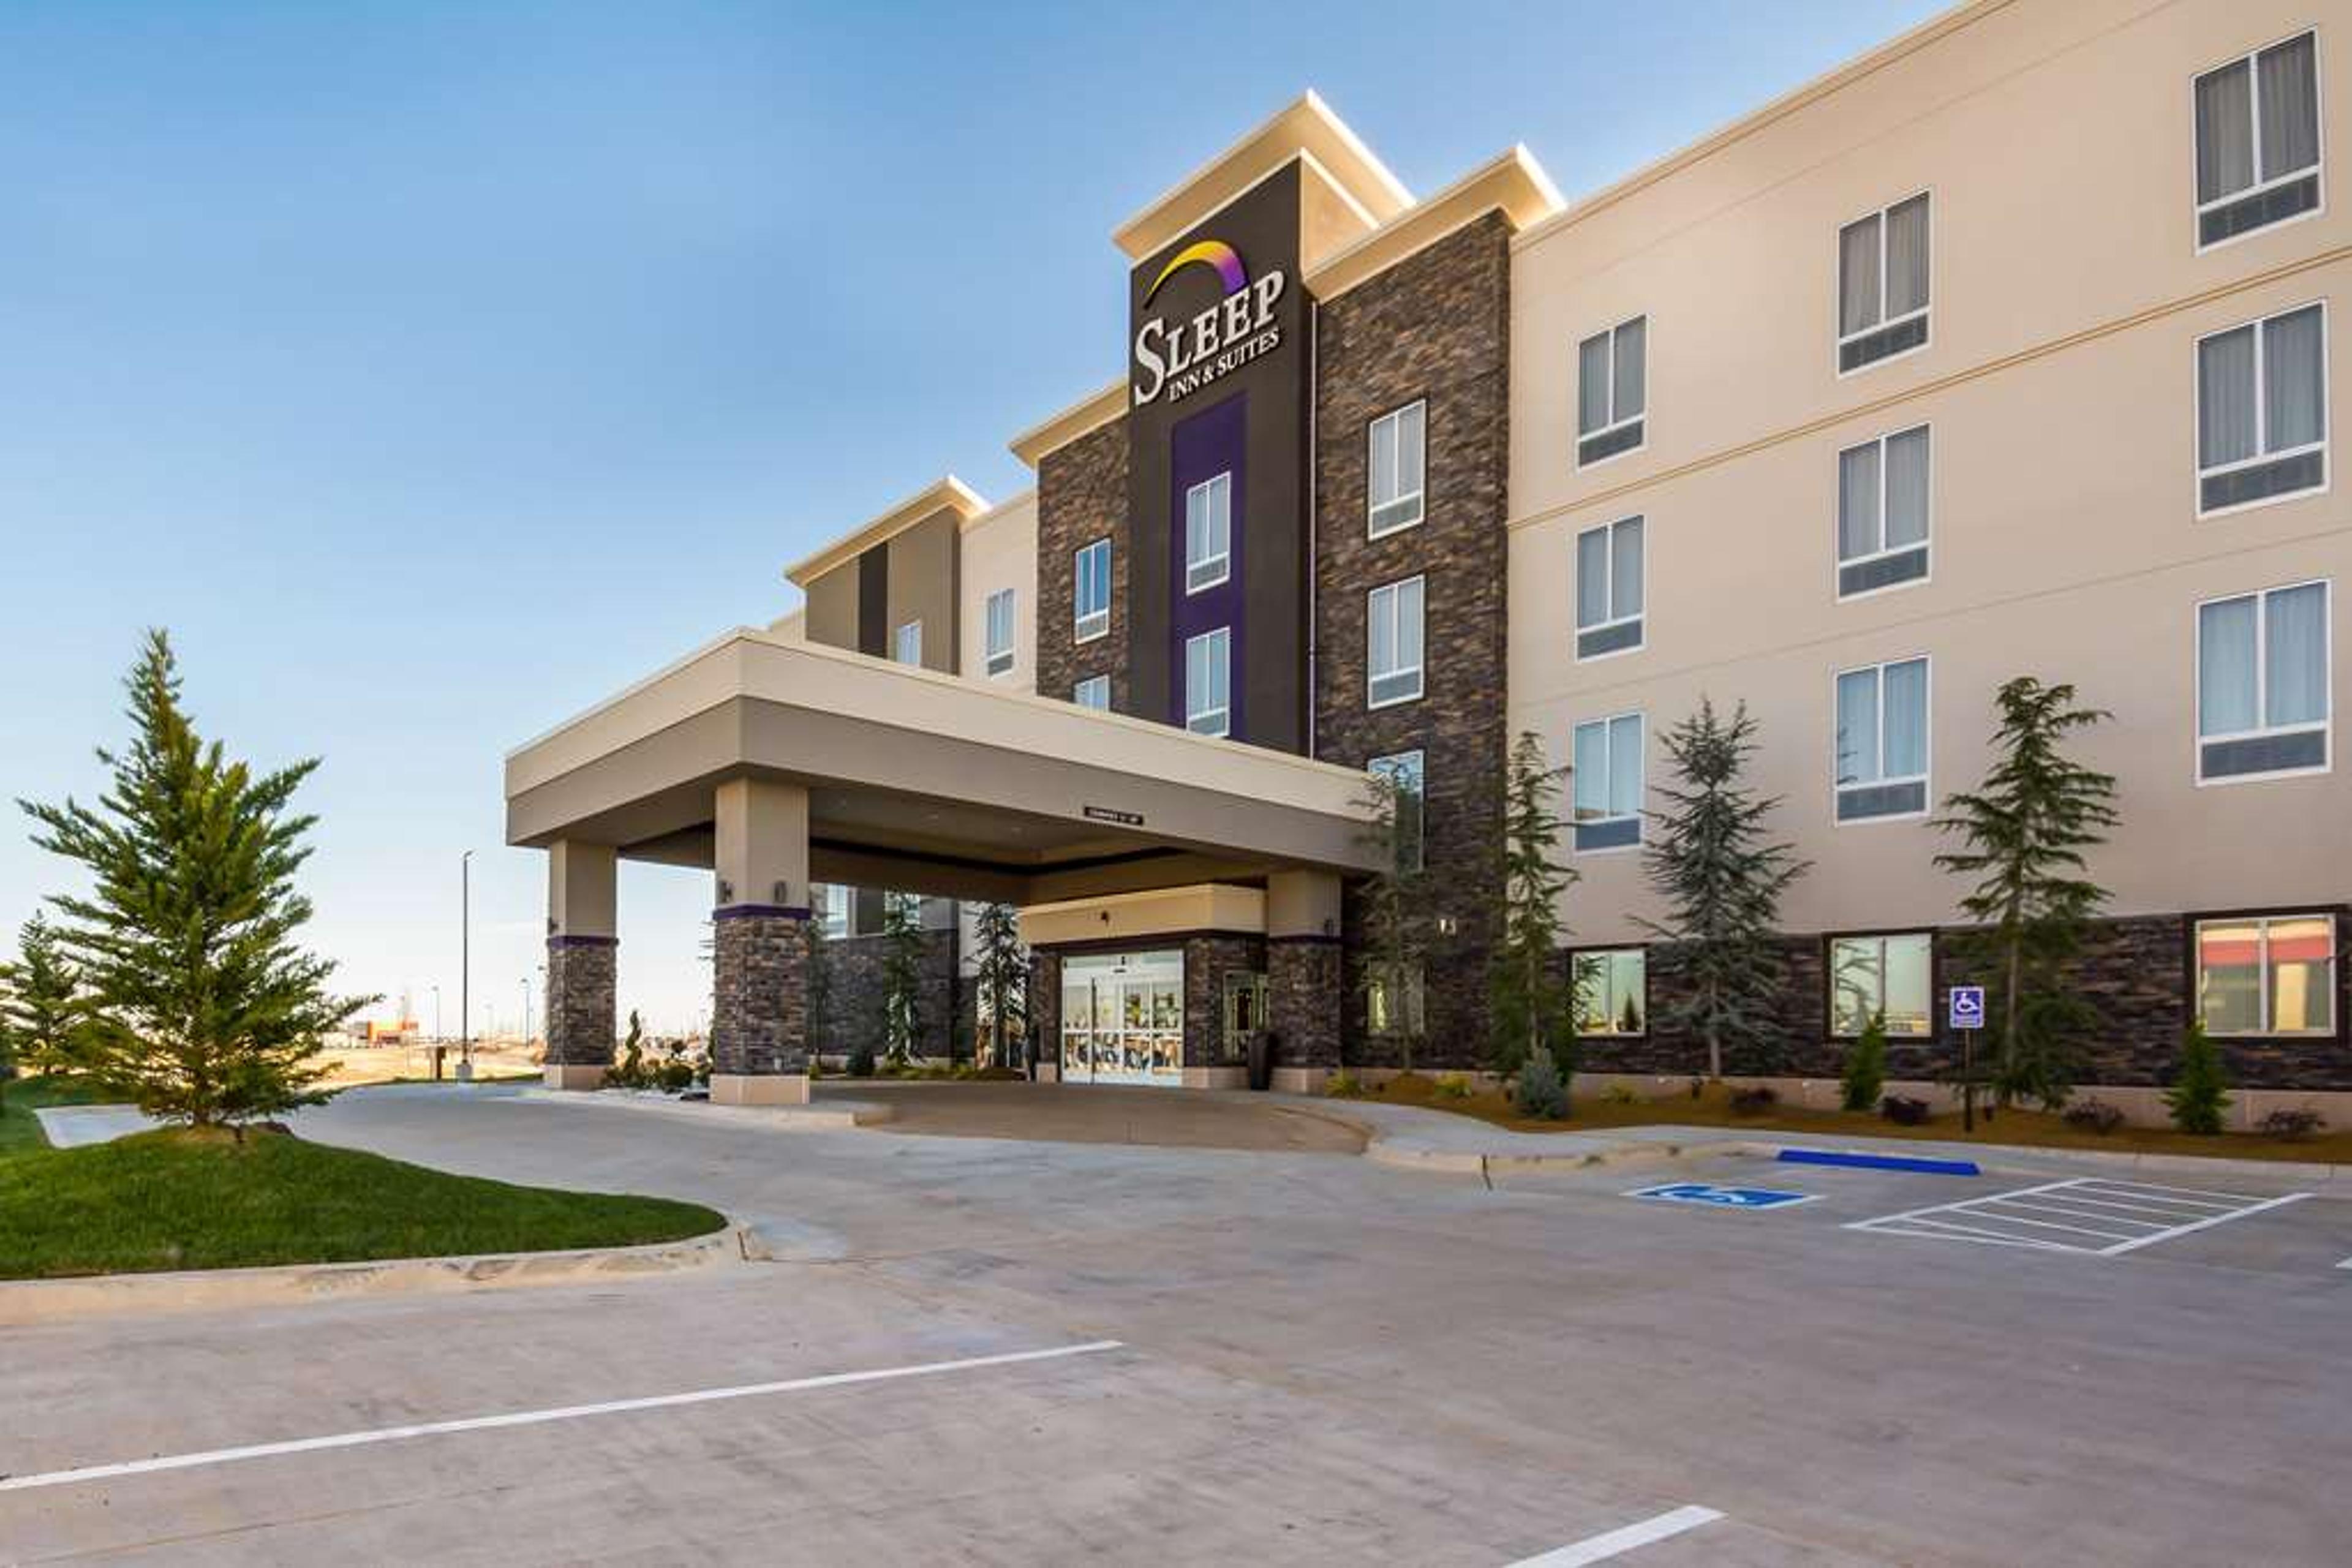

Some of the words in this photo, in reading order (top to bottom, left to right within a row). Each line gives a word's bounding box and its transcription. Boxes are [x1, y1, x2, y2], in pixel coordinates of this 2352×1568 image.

[1135, 271, 1284, 405] SLEEP
[1169, 370, 1202, 401] INN
[1202, 366, 1215, 384] &
[1217, 326, 1280, 376] SUITES
